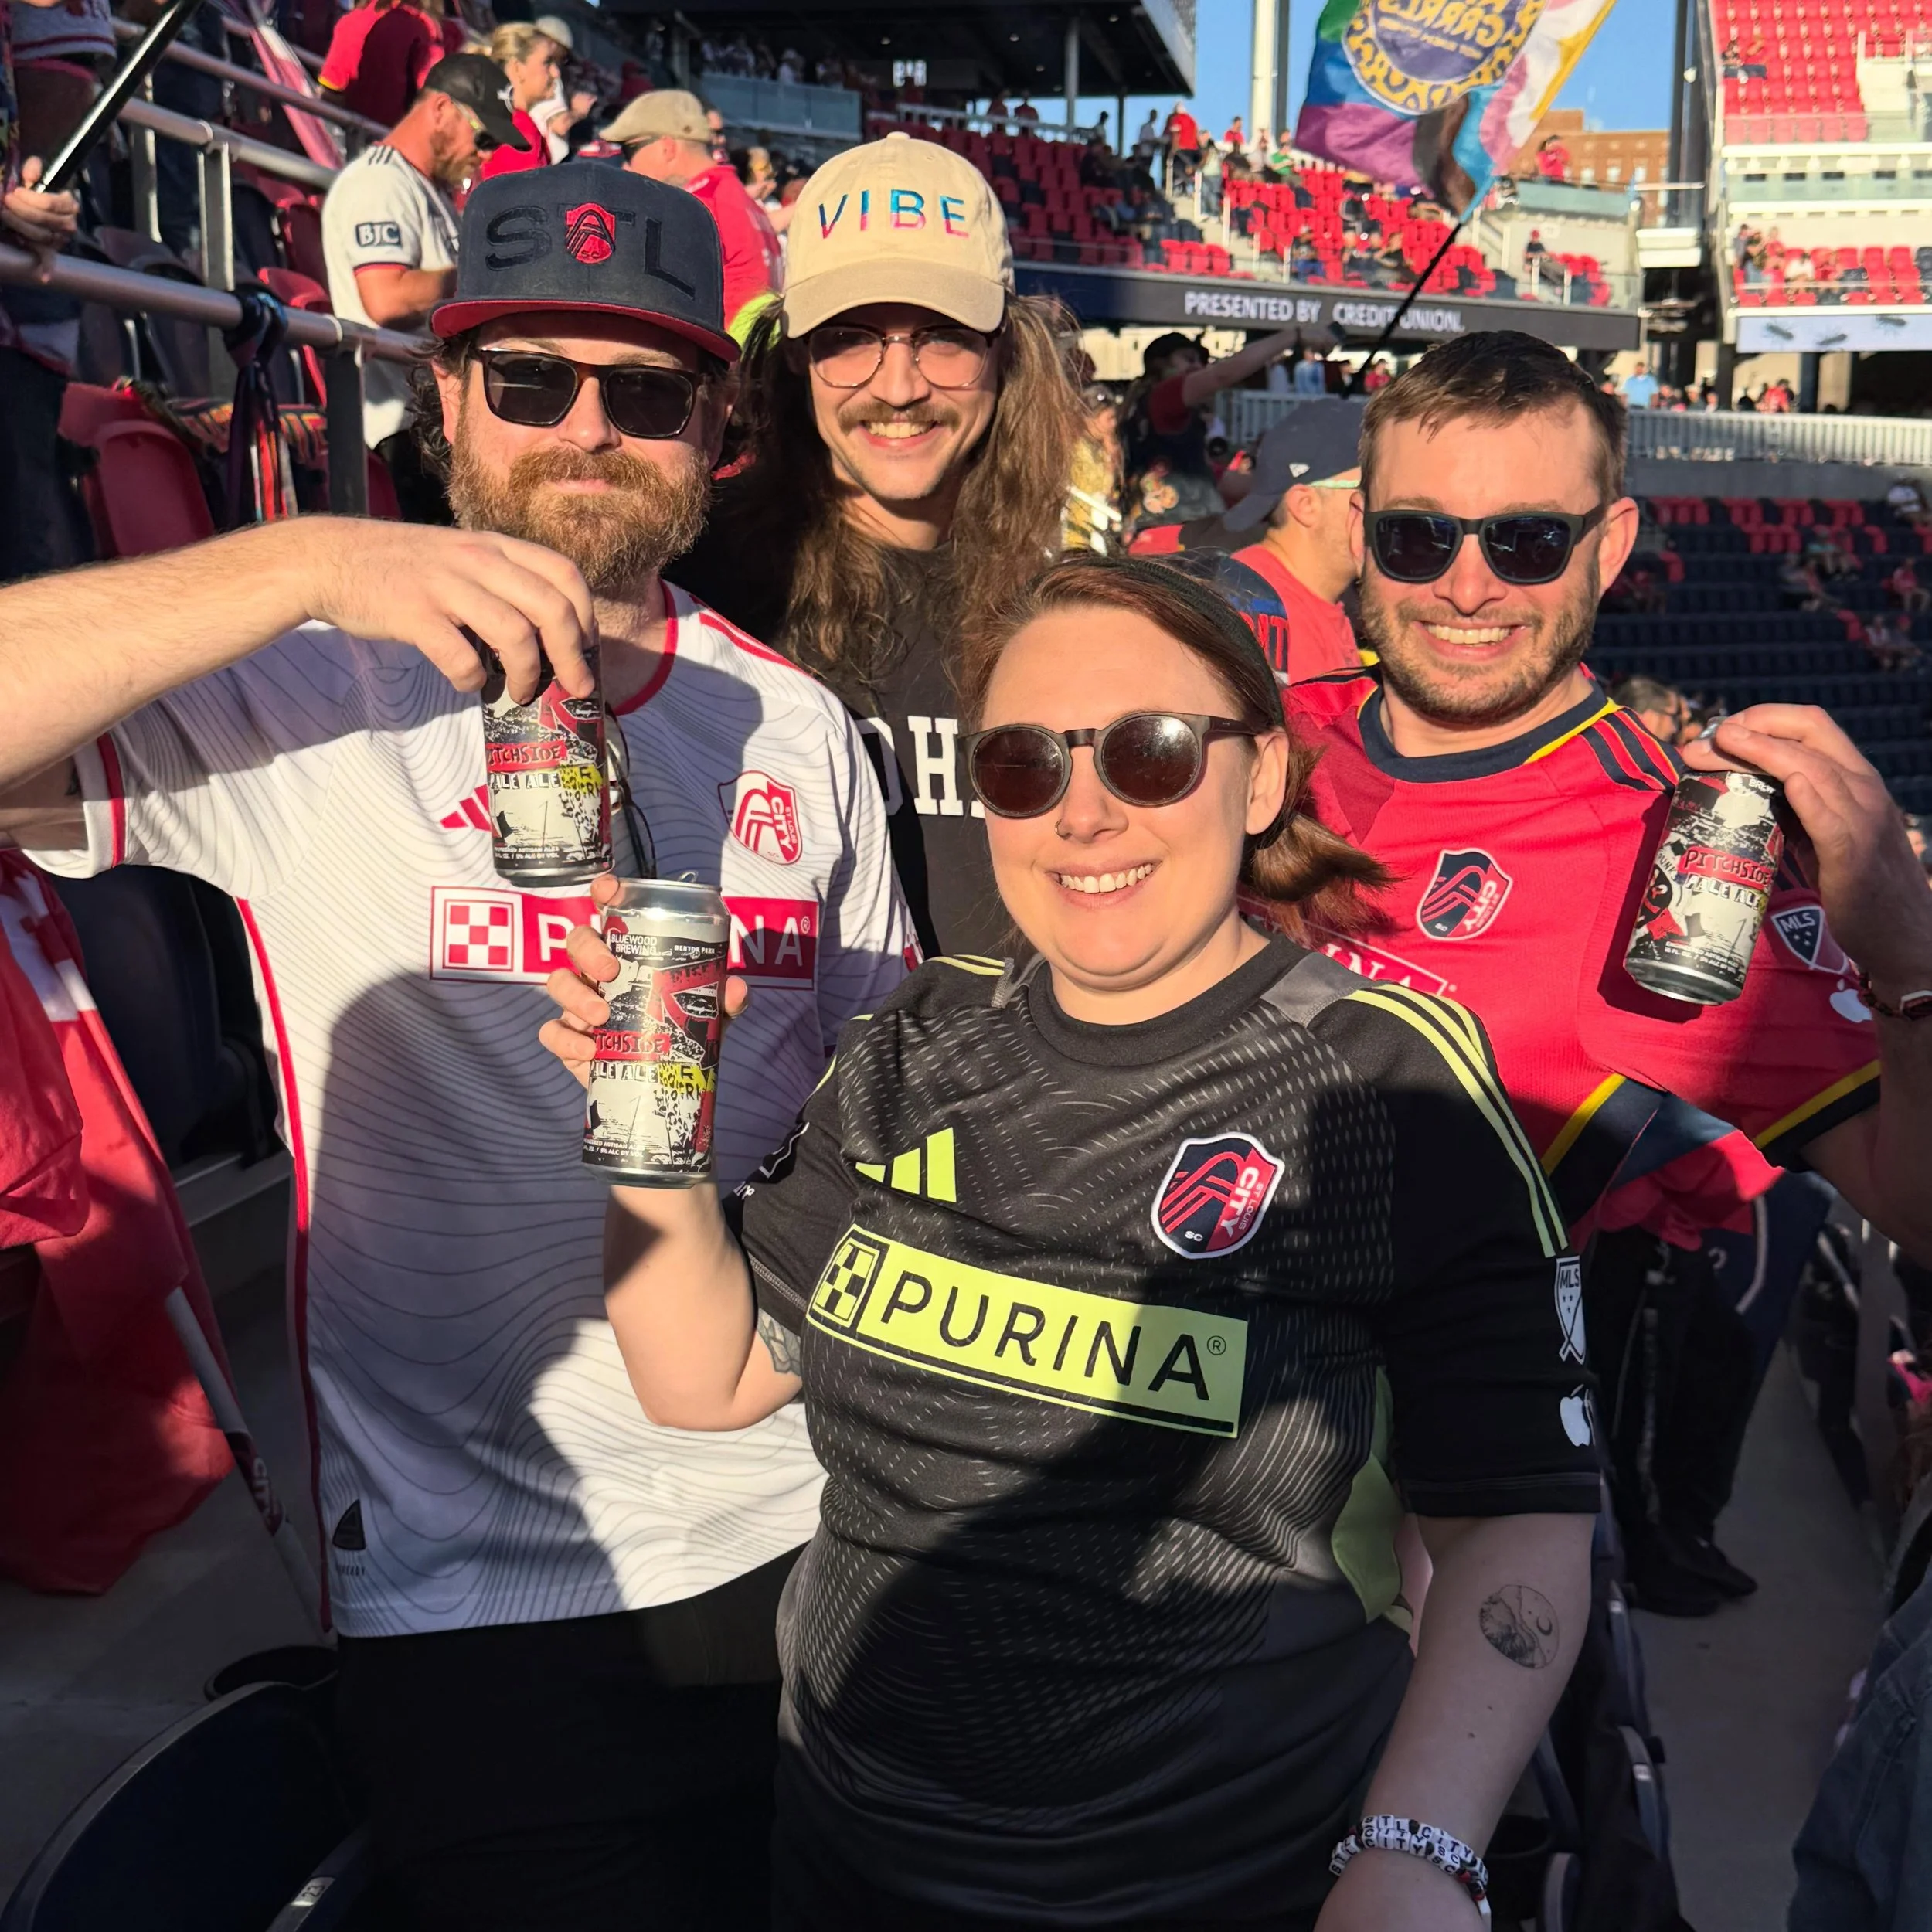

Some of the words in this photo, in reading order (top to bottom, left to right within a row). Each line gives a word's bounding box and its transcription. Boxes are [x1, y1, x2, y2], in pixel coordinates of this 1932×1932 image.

[819, 189, 968, 239] VIBE
[358, 223, 399, 246] BJC
[1185, 291, 1294, 321] PRESENTED
[1297, 299, 1322, 322] BY
[1332, 301, 1396, 326] CREDIT
[526, 772, 561, 789] ALE
[771, 796, 794, 852] CITY
[1685, 850, 1771, 884] PITCHSIDE
[1686, 875, 1730, 898] PALE
[1464, 880, 1497, 931] CITY
[1779, 912, 1816, 934] MLS
[611, 934, 657, 946] BLUEWOOD
[616, 944, 657, 956] BREWING
[621, 1064, 657, 1083] ALE
[1221, 1166, 1260, 1237] CITY
[1255, 1182, 1264, 1198] ST
[1239, 1201, 1258, 1230] LOUIS
[1185, 1230, 1203, 1242] SC
[1560, 1268, 1580, 1289] MLS
